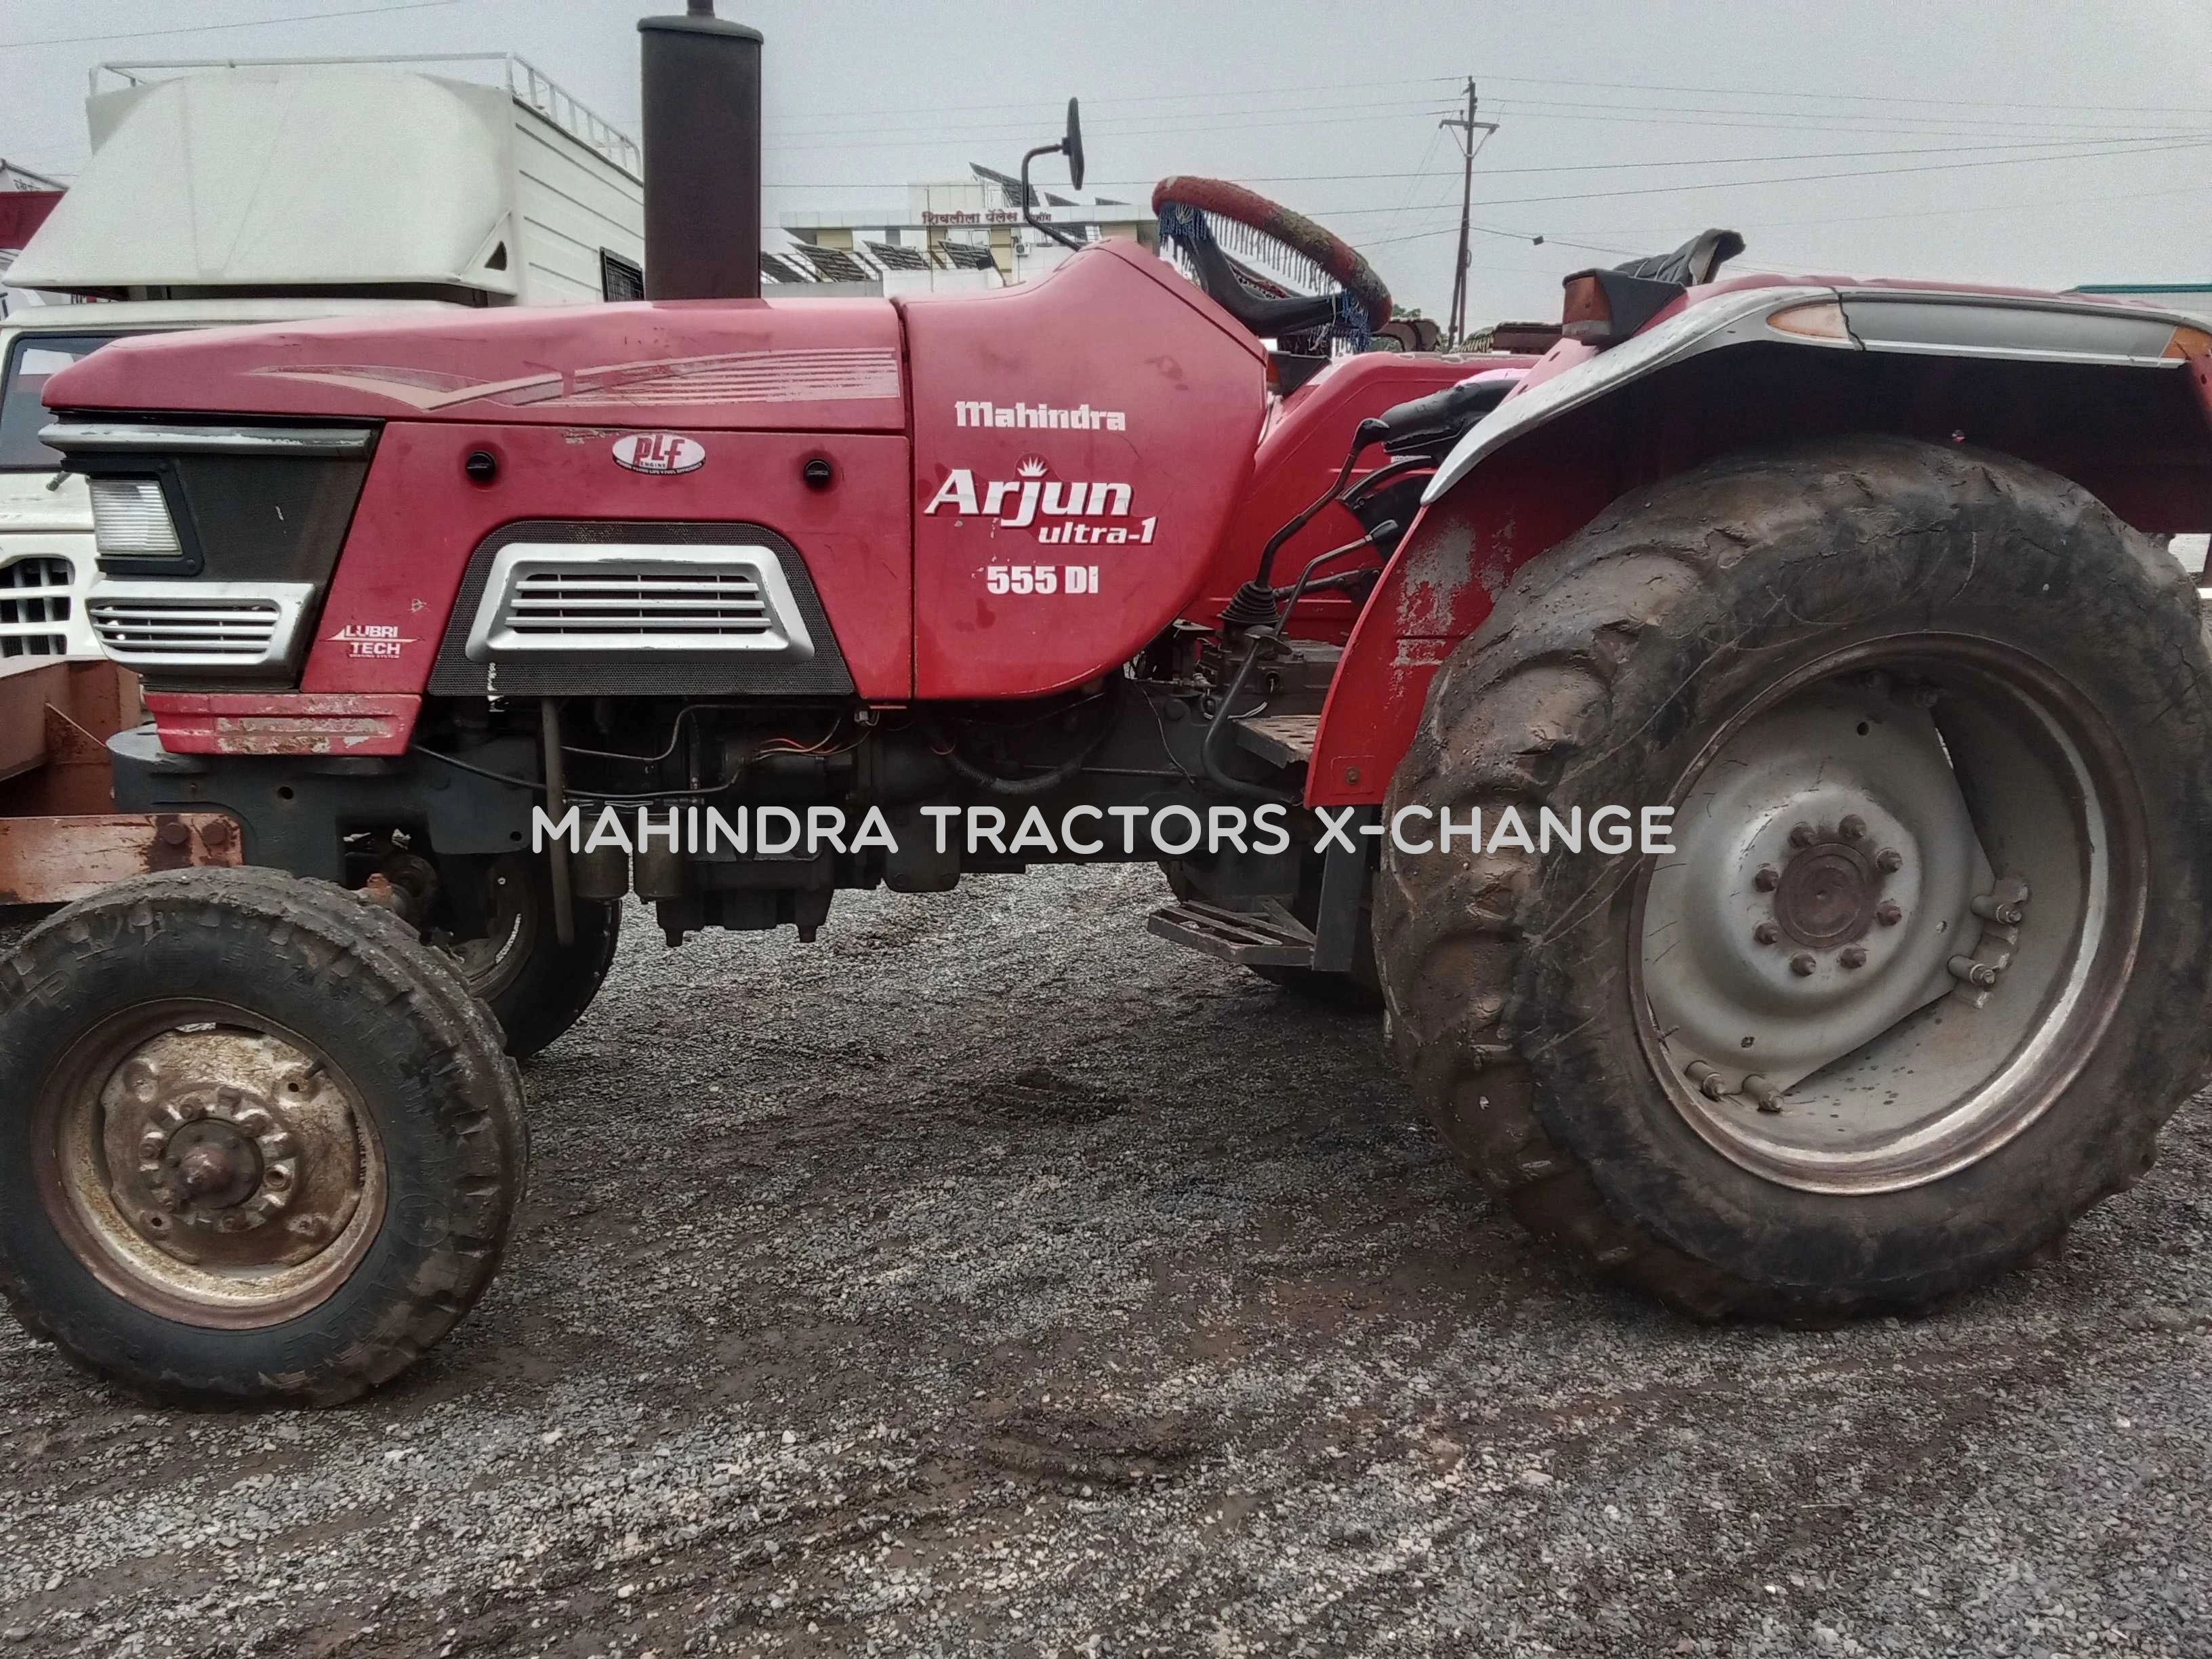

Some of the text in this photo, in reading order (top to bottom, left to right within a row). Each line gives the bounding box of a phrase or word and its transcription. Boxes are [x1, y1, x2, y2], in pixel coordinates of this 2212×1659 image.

[924, 468, 1132, 528] Arjun
[1038, 516, 1159, 544] ultra-1
[987, 565, 1099, 594] 555 DI
[345, 625, 398, 638] LUBRI
[350, 642, 401, 655] TECH
